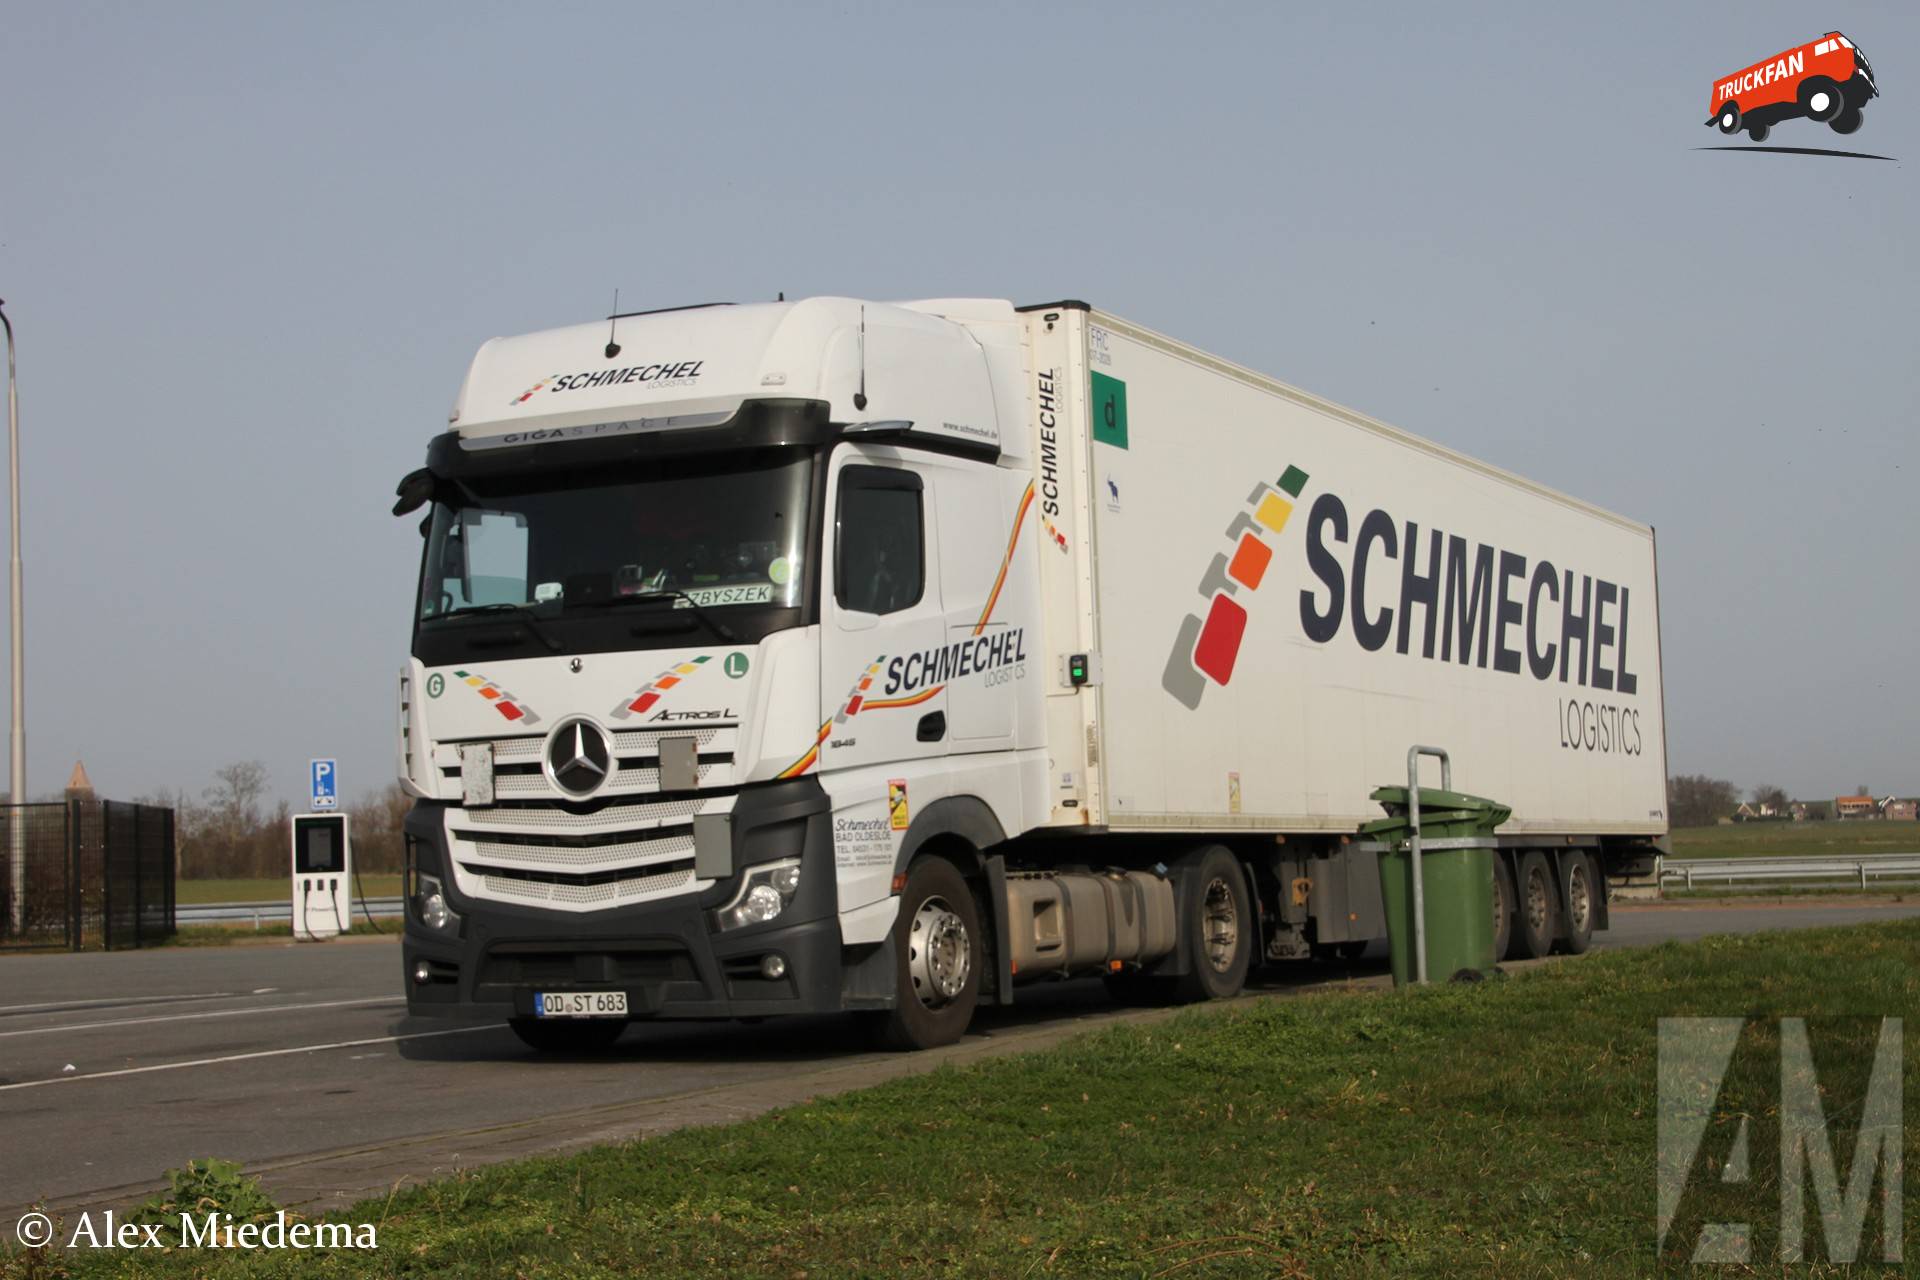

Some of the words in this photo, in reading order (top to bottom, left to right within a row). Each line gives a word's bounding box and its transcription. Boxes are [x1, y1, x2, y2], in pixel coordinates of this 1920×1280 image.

[552, 361, 704, 392] SCHMECHEL
[504, 416, 678, 444] GIGASPACE
[1038, 368, 1059, 516] SCHMECHEL
[1300, 493, 1638, 695] SCHMECHEL
[730, 655, 743, 677] L
[885, 627, 1026, 695] SCHMECHEL
[430, 677, 442, 694] G
[1559, 697, 1642, 756] LOGISTICS
[316, 763, 331, 782] P
[836, 832, 854, 843] BAD
[544, 995, 564, 1012] OD
[574, 995, 592, 1012] ST
[597, 994, 625, 1012] 683
